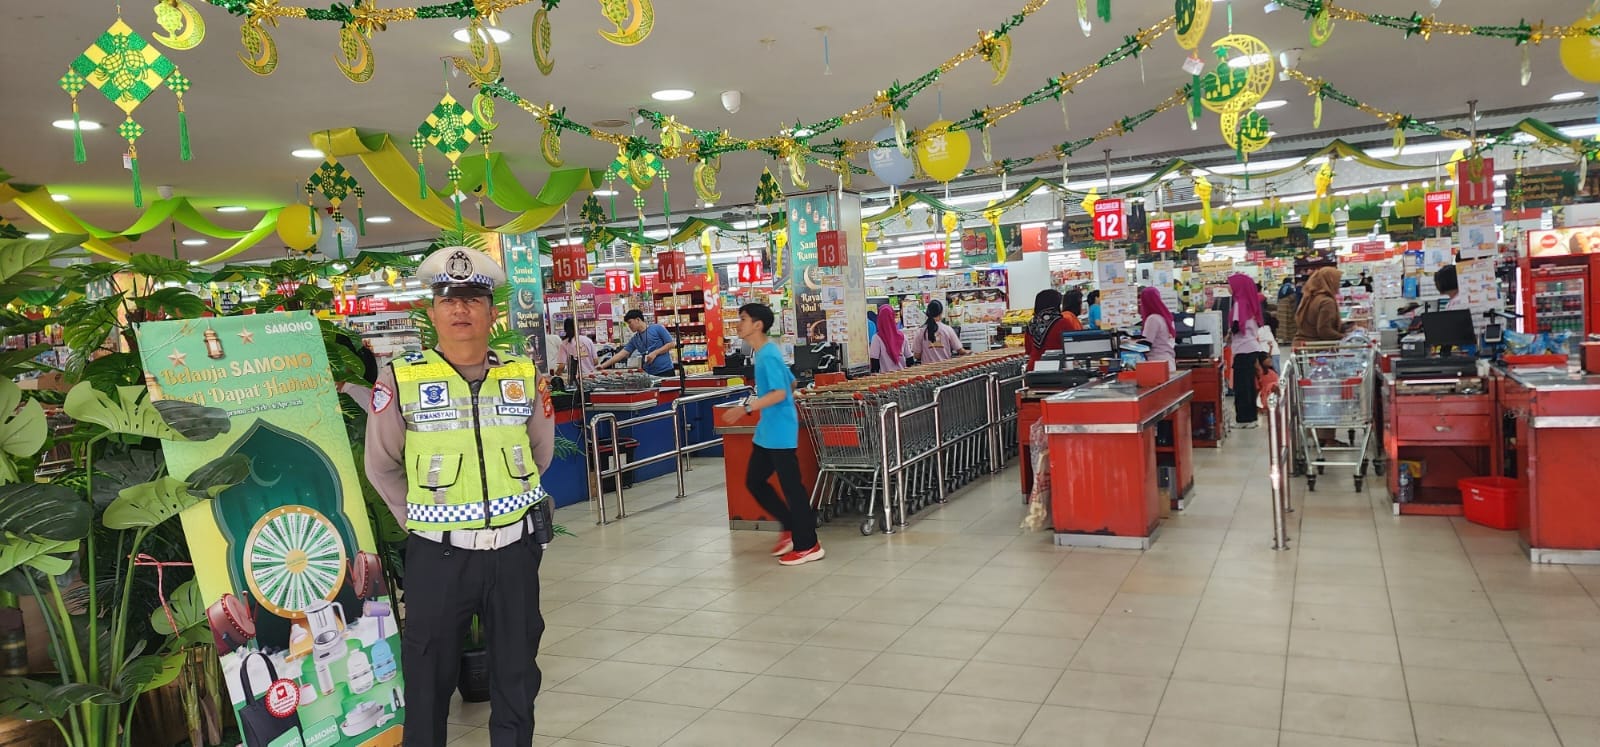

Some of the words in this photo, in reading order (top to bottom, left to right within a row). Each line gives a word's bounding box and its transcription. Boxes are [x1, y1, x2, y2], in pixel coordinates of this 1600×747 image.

[1095, 202, 1120, 211] CASHIER
[1435, 203, 1444, 224] 1
[1097, 213, 1119, 238] 12
[1156, 230, 1167, 249] 2
[821, 244, 836, 264] 13
[930, 252, 938, 268] 3
[555, 258, 571, 277] 15
[574, 257, 587, 277] 15
[660, 264, 673, 280] 14
[676, 264, 686, 280] 14
[743, 264, 750, 280] 4
[265, 321, 313, 335] SAMONO
[160, 364, 227, 386] Belanja
[230, 352, 313, 378] SAMONO
[208, 383, 261, 405] Dapat
[500, 406, 530, 416] POLRI
[306, 724, 338, 745] SAMONO
